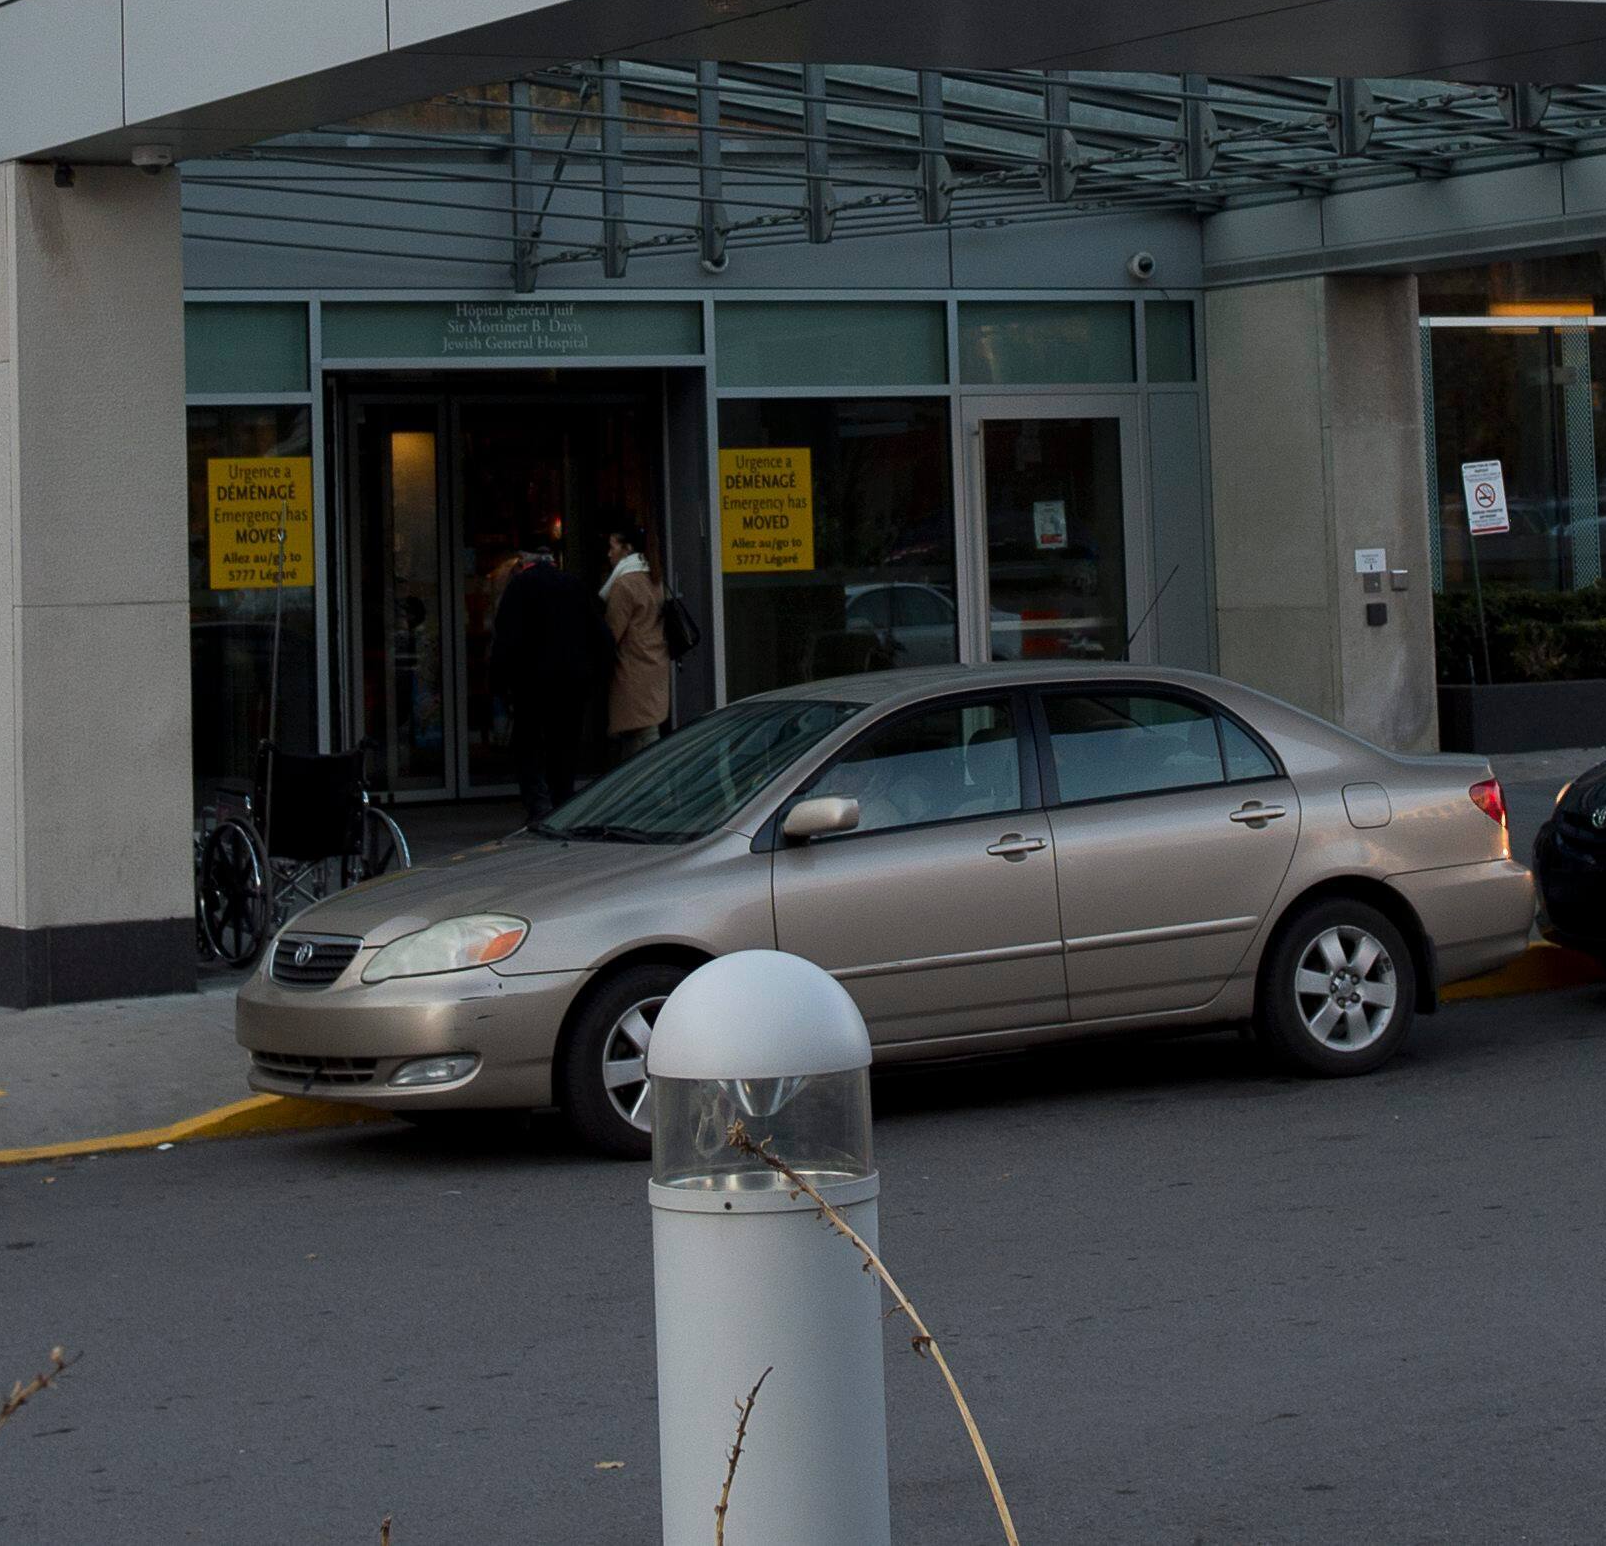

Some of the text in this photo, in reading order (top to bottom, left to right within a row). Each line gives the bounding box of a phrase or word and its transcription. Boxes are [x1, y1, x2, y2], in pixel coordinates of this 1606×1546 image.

[455, 302, 575, 320] Hôpital général juif
[447, 320, 465, 333] Sir
[468, 319, 528, 333] Mortimer
[549, 319, 583, 333] Davis
[442, 335, 589, 353] Jewish General Hospital
[736, 455, 792, 473] Urgence a
[228, 464, 292, 485] Urgence a
[725, 471, 797, 490] DÉMÉNAGÉ
[217, 483, 296, 502] DÉMÉNAGÉ
[722, 495, 807, 514] Emergency has
[214, 505, 308, 527] Emergency has
[742, 515, 789, 530] MOVED
[235, 527, 287, 544] MOVED
[731, 538, 756, 549] Allez
[792, 537, 802, 548] to
[223, 553, 251, 564] Allez
[290, 553, 302, 563] to
[736, 554, 762, 565] 5777
[228, 569, 256, 582] 5777
